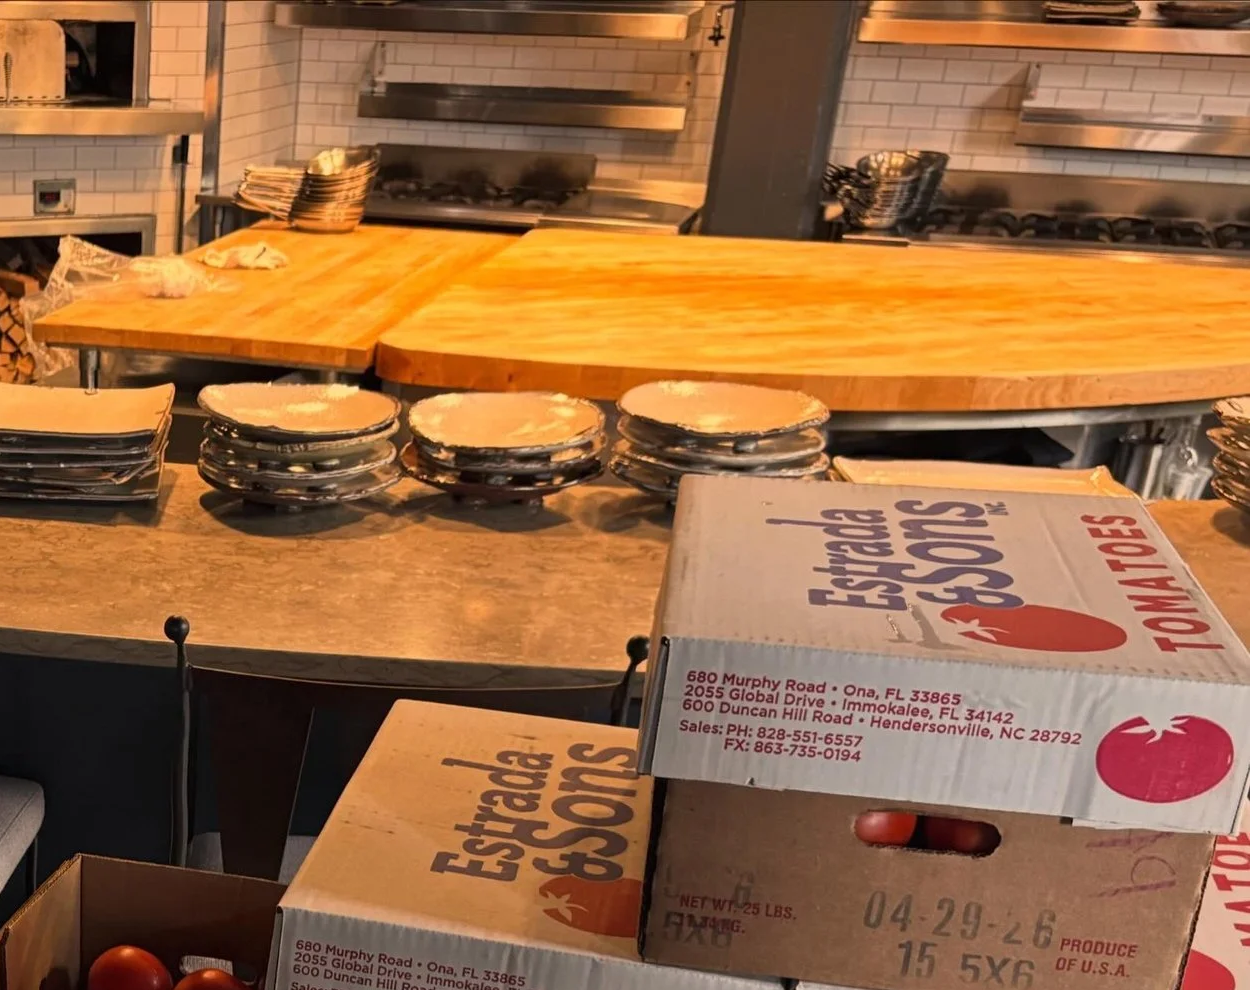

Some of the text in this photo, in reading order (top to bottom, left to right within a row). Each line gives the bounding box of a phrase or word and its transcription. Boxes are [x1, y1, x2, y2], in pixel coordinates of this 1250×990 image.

[766, 509, 915, 611] Estrada
[1080, 515, 1225, 653] TOMATOES
[684, 684, 1013, 724] 2055 Global Drive Immokalee, FL 34142
[686, 669, 961, 705] 680 Murphy Road Ona, FL 33865
[678, 718, 863, 747] Sales: PH: 828-551-6557
[682, 697, 1082, 746] 600 Duncan Hill Road Hendersonville, NC 28792
[723, 737, 861, 762] FX: 863-735-0194
[430, 750, 553, 882] Estrada
[680, 895, 707, 909] NET
[743, 902, 760, 916] 25
[765, 904, 797, 920] LBS.
[898, 940, 937, 979] 15
[1060, 937, 1138, 958] PRODUCE
[1055, 957, 1130, 978] OF U.S.A.
